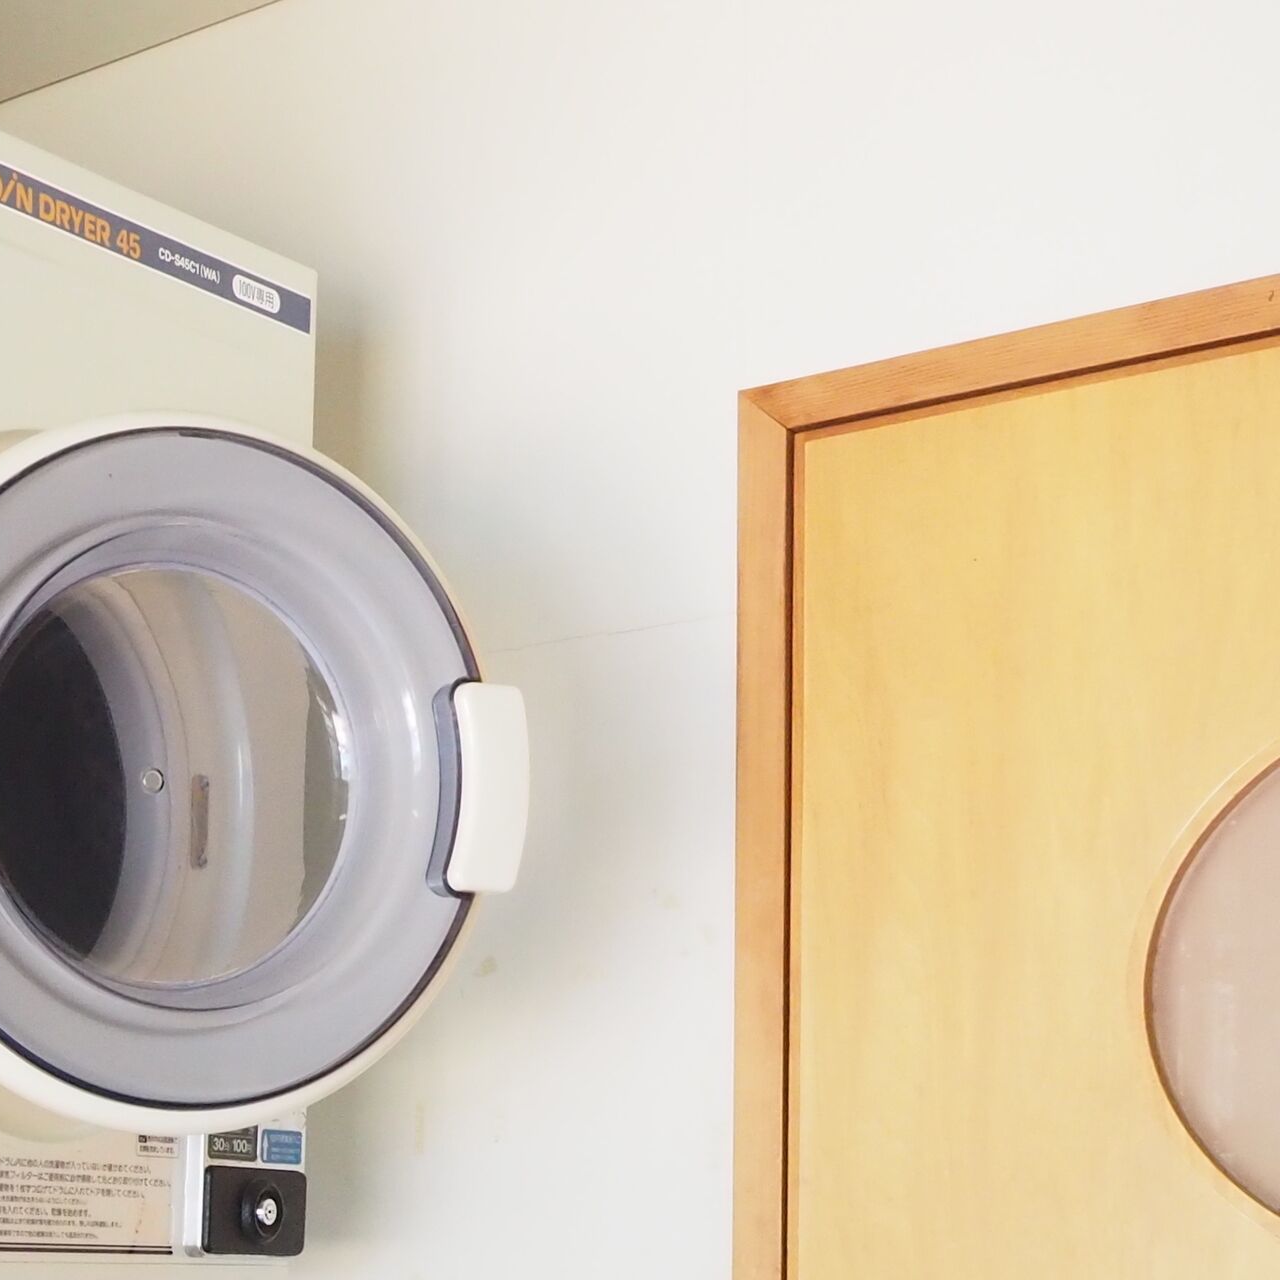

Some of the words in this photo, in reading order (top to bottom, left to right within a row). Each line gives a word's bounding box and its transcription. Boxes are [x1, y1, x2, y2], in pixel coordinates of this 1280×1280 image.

[39, 194, 111, 246] DRYER
[116, 227, 141, 260] 45
[158, 246, 221, 285] CD-S45C1(WA)
